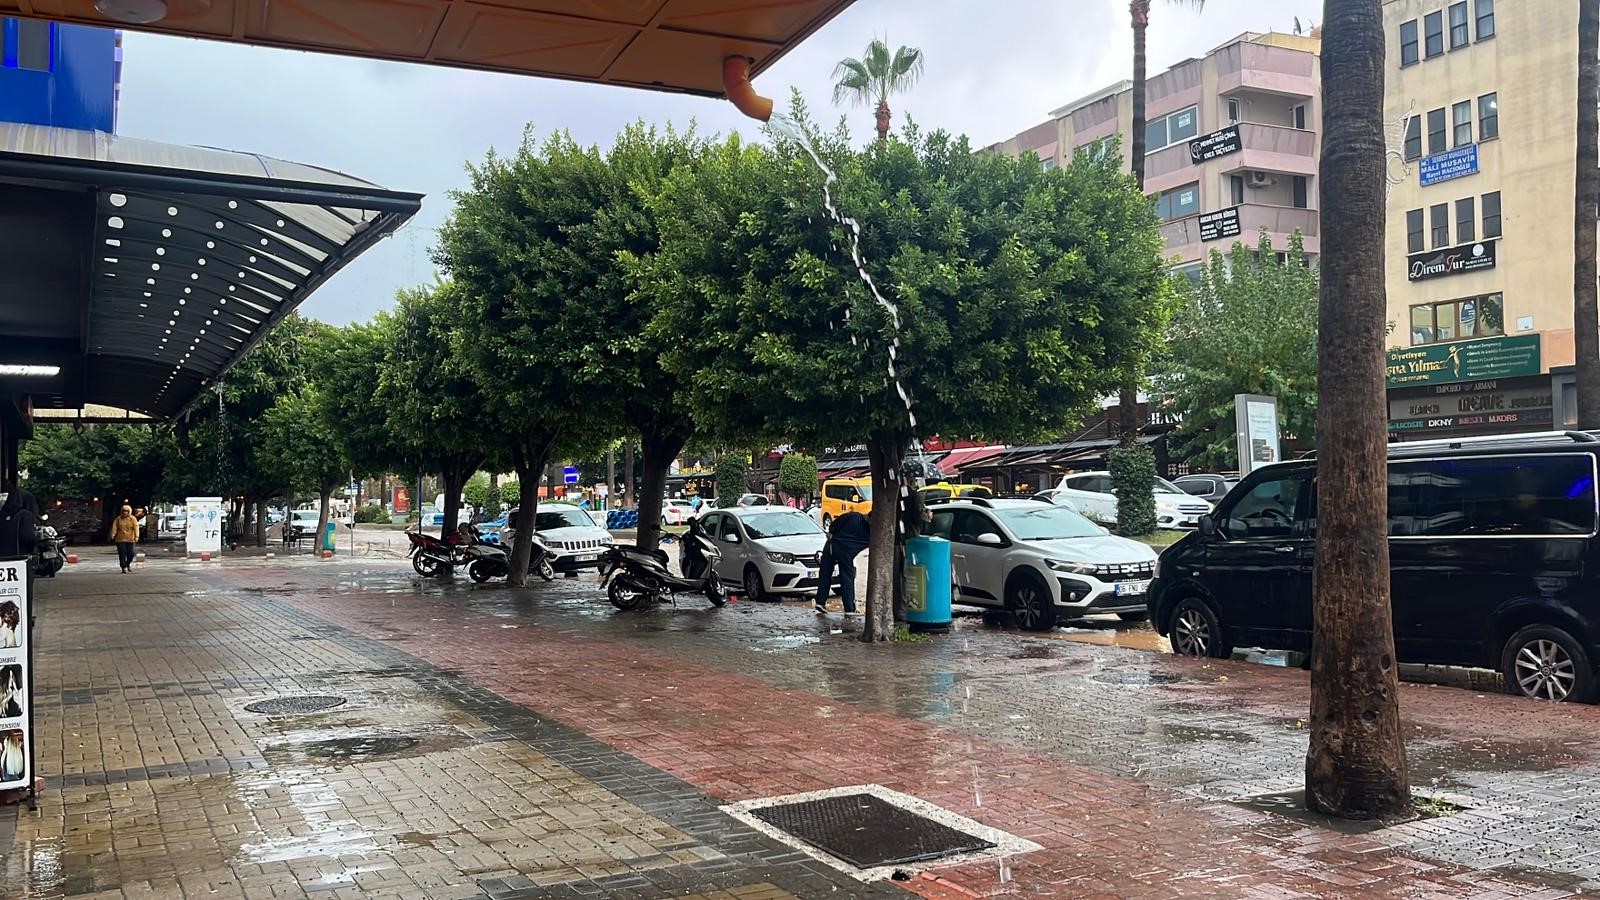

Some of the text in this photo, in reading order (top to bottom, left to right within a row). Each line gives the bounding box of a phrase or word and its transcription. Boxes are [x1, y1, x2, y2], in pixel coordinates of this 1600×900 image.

[1409, 260, 1445, 279] Direm
[1445, 253, 1466, 273] Tur
[1391, 351, 1427, 362] Diyetisyen
[1436, 380, 1497, 393] EMPORIO ARMANI
[1396, 420, 1425, 430] LACOSTE
[1428, 418, 1453, 428] DKNY
